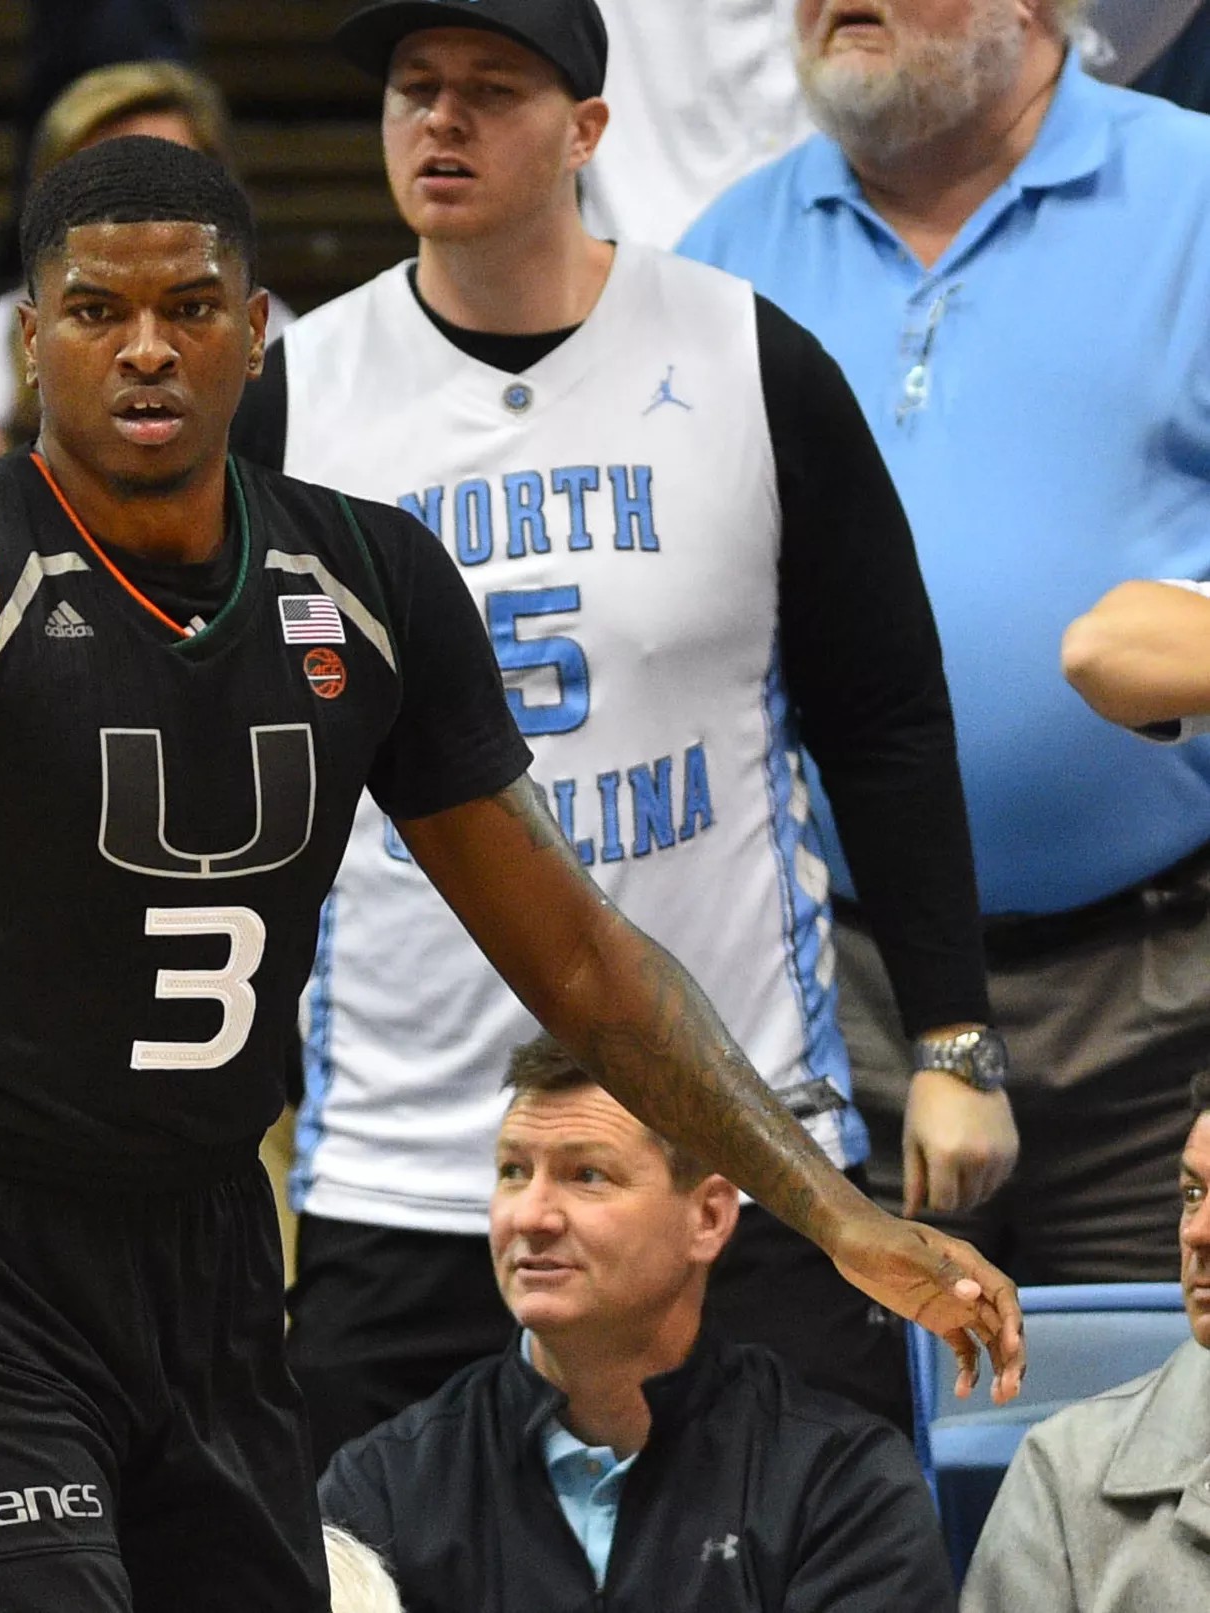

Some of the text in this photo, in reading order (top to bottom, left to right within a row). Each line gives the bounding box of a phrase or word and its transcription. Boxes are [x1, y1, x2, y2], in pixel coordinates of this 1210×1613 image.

[44, 624, 94, 638] adidas
[486, 585, 591, 737] 5
[98, 723, 316, 879] U
[130, 906, 266, 1070] 3
